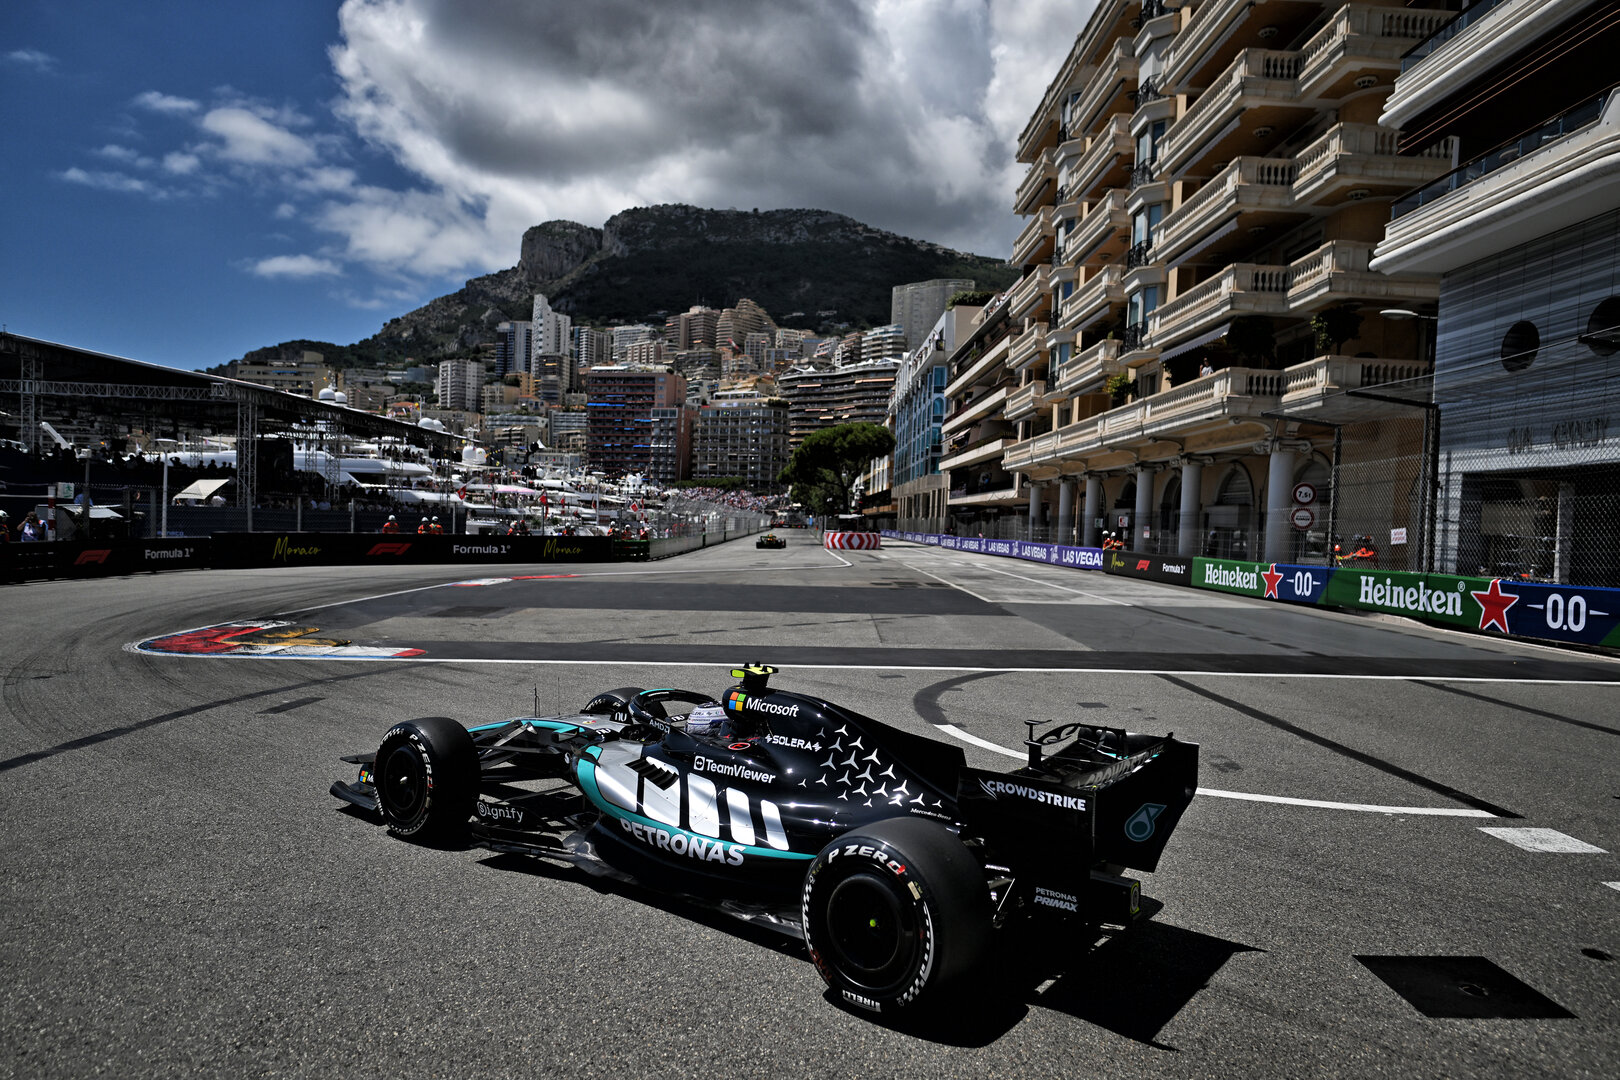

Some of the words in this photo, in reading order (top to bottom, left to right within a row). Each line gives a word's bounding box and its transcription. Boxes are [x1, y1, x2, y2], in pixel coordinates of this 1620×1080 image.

[144, 548, 183, 560] Formula
[272, 535, 322, 562] Monaco
[453, 544, 499, 554] Formula
[543, 538, 583, 560] Monaco
[988, 542, 996, 553] LAS
[996, 542, 1010, 554] VEGAS
[1021, 545, 1031, 557] LAS
[1030, 546, 1047, 560] VEGAS
[1062, 549, 1075, 564] LAS
[1162, 563, 1181, 574] Formula
[745, 697, 799, 718] Microsoft
[771, 734, 813, 751] SOLERA
[706, 757, 776, 784] TeamViewer
[986, 780, 1087, 812] CROWDSTRIKE
[910, 808, 952, 820] Mercedes-Benz
[620, 817, 746, 866] PETRONAS
[828, 848, 840, 864] P
[843, 844, 906, 875] ZERO
[1035, 886, 1077, 903] PETRONAS
[1033, 895, 1079, 912] PRIMAX
